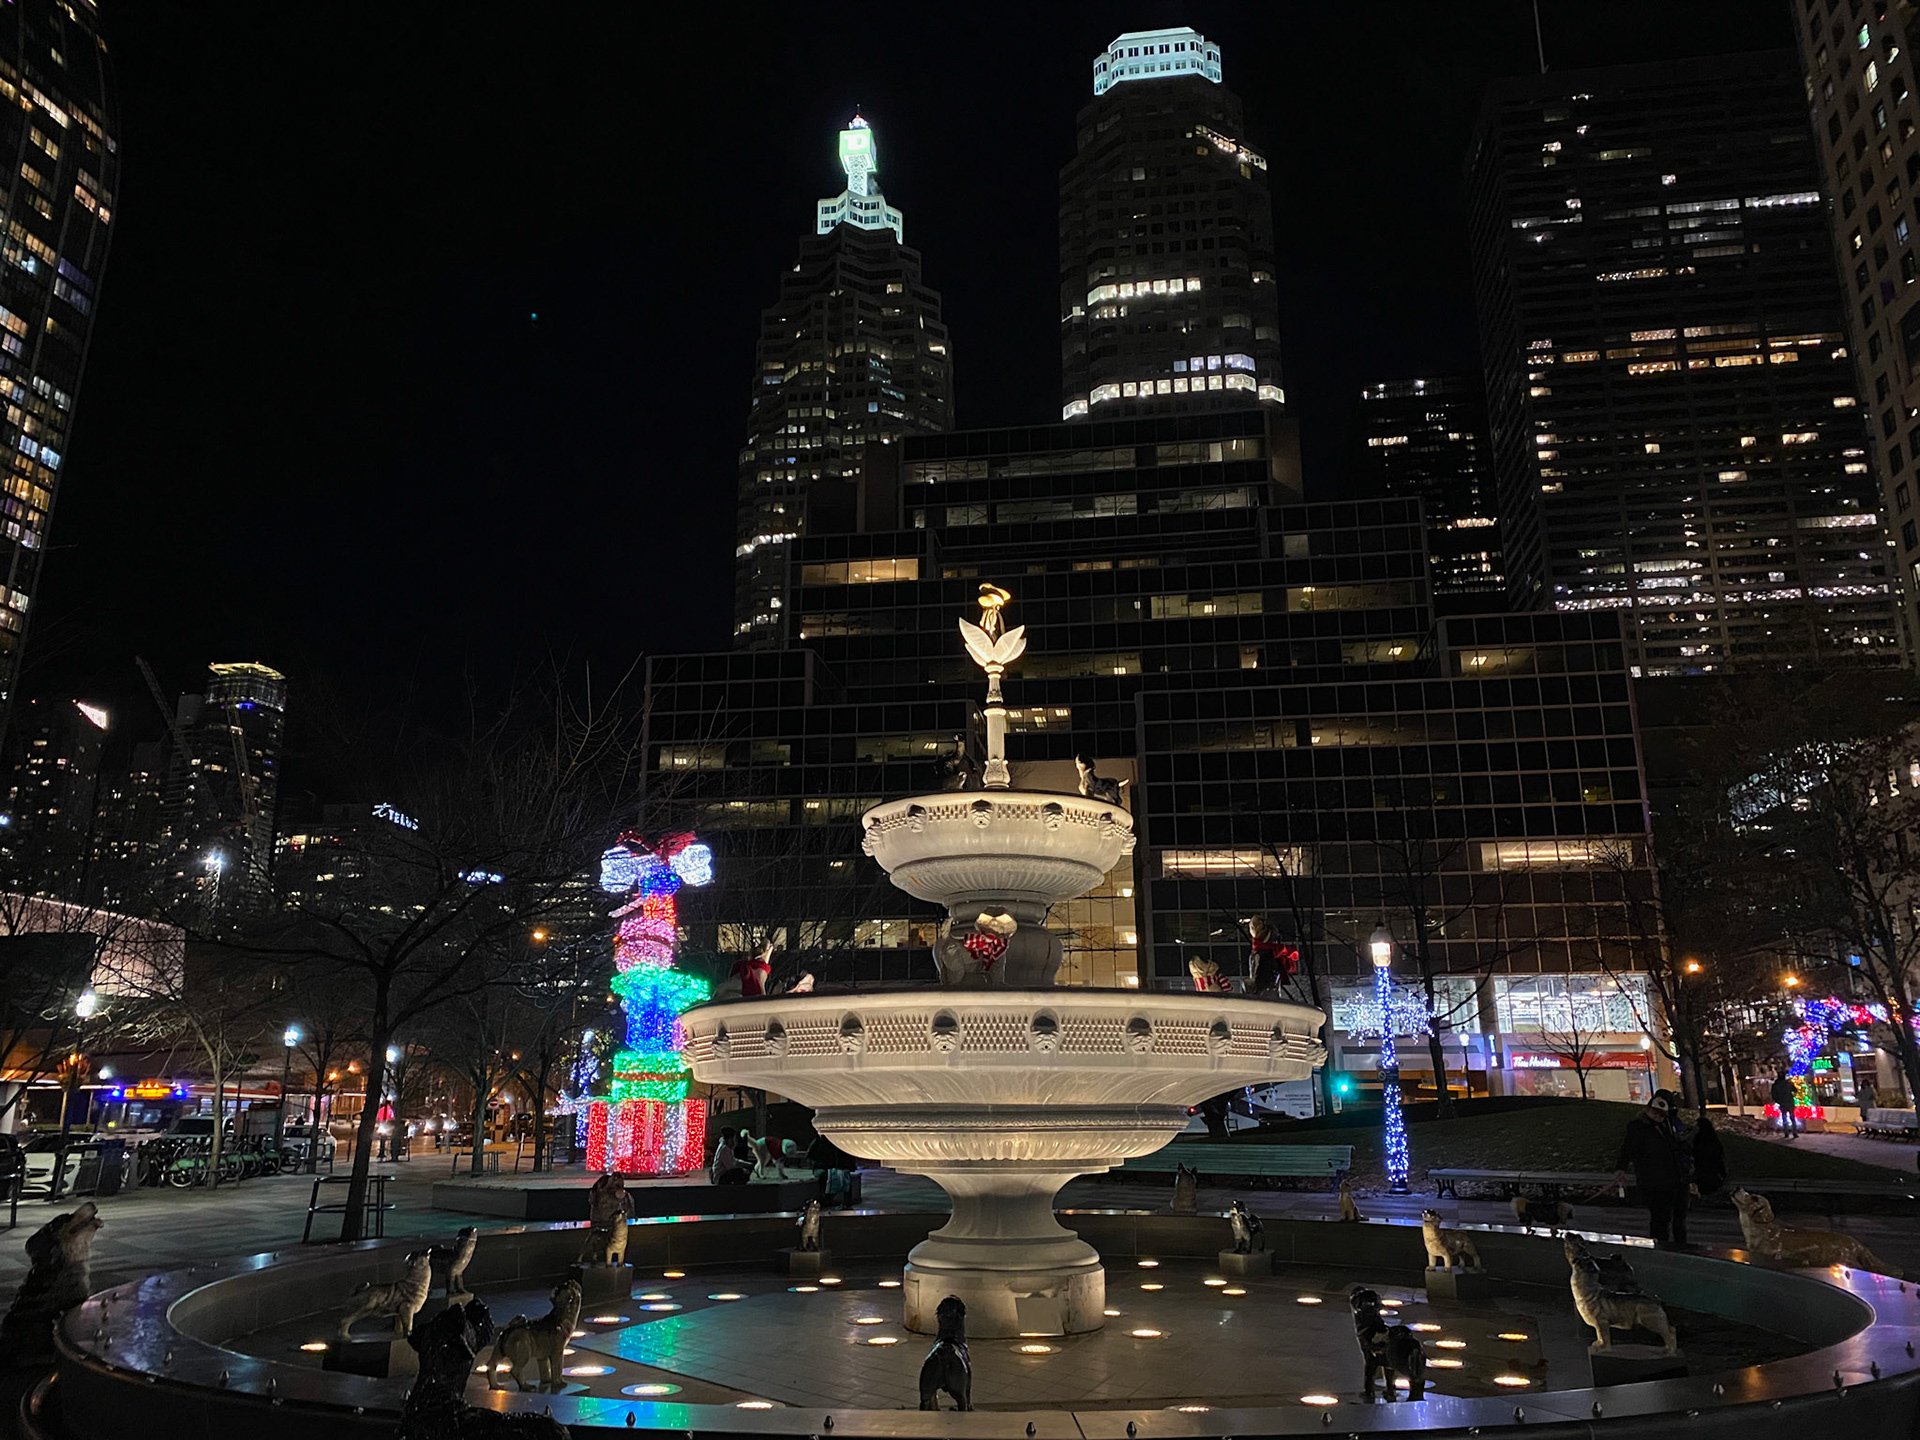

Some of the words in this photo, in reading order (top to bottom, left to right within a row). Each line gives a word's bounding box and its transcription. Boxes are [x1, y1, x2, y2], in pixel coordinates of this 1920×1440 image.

[843, 134, 867, 150] TD
[388, 808, 419, 830] TELUS
[1512, 1056, 1529, 1067] Tim
[1529, 1055, 1561, 1067] Hortons
